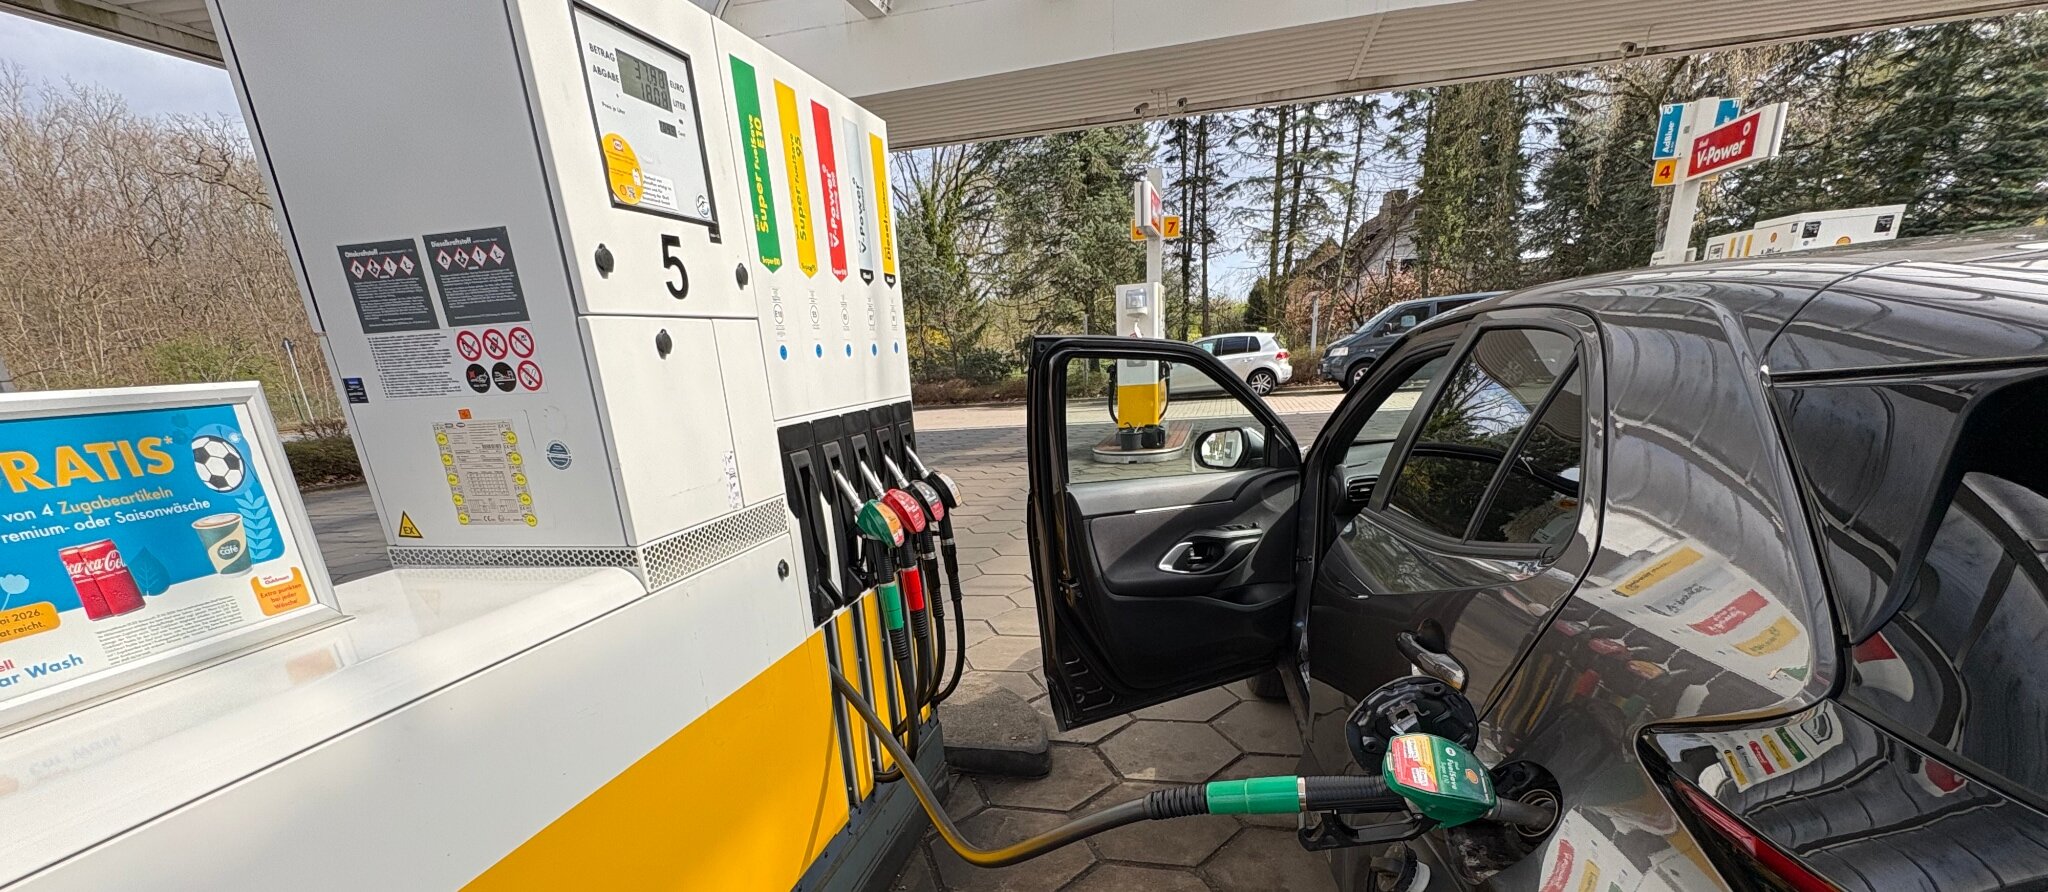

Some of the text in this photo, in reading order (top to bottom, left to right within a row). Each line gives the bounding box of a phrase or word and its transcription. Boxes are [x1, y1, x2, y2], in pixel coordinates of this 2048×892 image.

[588, 43, 615, 62] BETRAG
[669, 80, 685, 94] EURO
[592, 65, 619, 84] ABGABE
[1663, 105, 1673, 115] 10
[754, 117, 765, 149] E10
[795, 136, 802, 157] 95
[1662, 121, 1675, 153] AdBlue
[1697, 139, 1746, 168] V-Power
[749, 114, 769, 233] Super FuelSave
[1659, 165, 1671, 179] 4
[796, 188, 807, 240] Super
[826, 170, 840, 247] V-Power
[856, 183, 867, 253] V-Power
[883, 219, 891, 261] Diesel
[1168, 221, 1176, 233] 7
[661, 234, 689, 300] 5
[2, 486, 173, 523] von 4 Zugabeartikeln
[0, 498, 211, 544] remium- oder Saisonwäsche
[403, 526, 416, 535] EX
[278, 584, 302, 594] punkten
[282, 593, 297, 601] jeder
[12, 609, 44, 622] 2026.
[13, 621, 46, 634] reicht.
[24, 654, 84, 678] Wash
[1447, 758, 1457, 790] FuelSave
